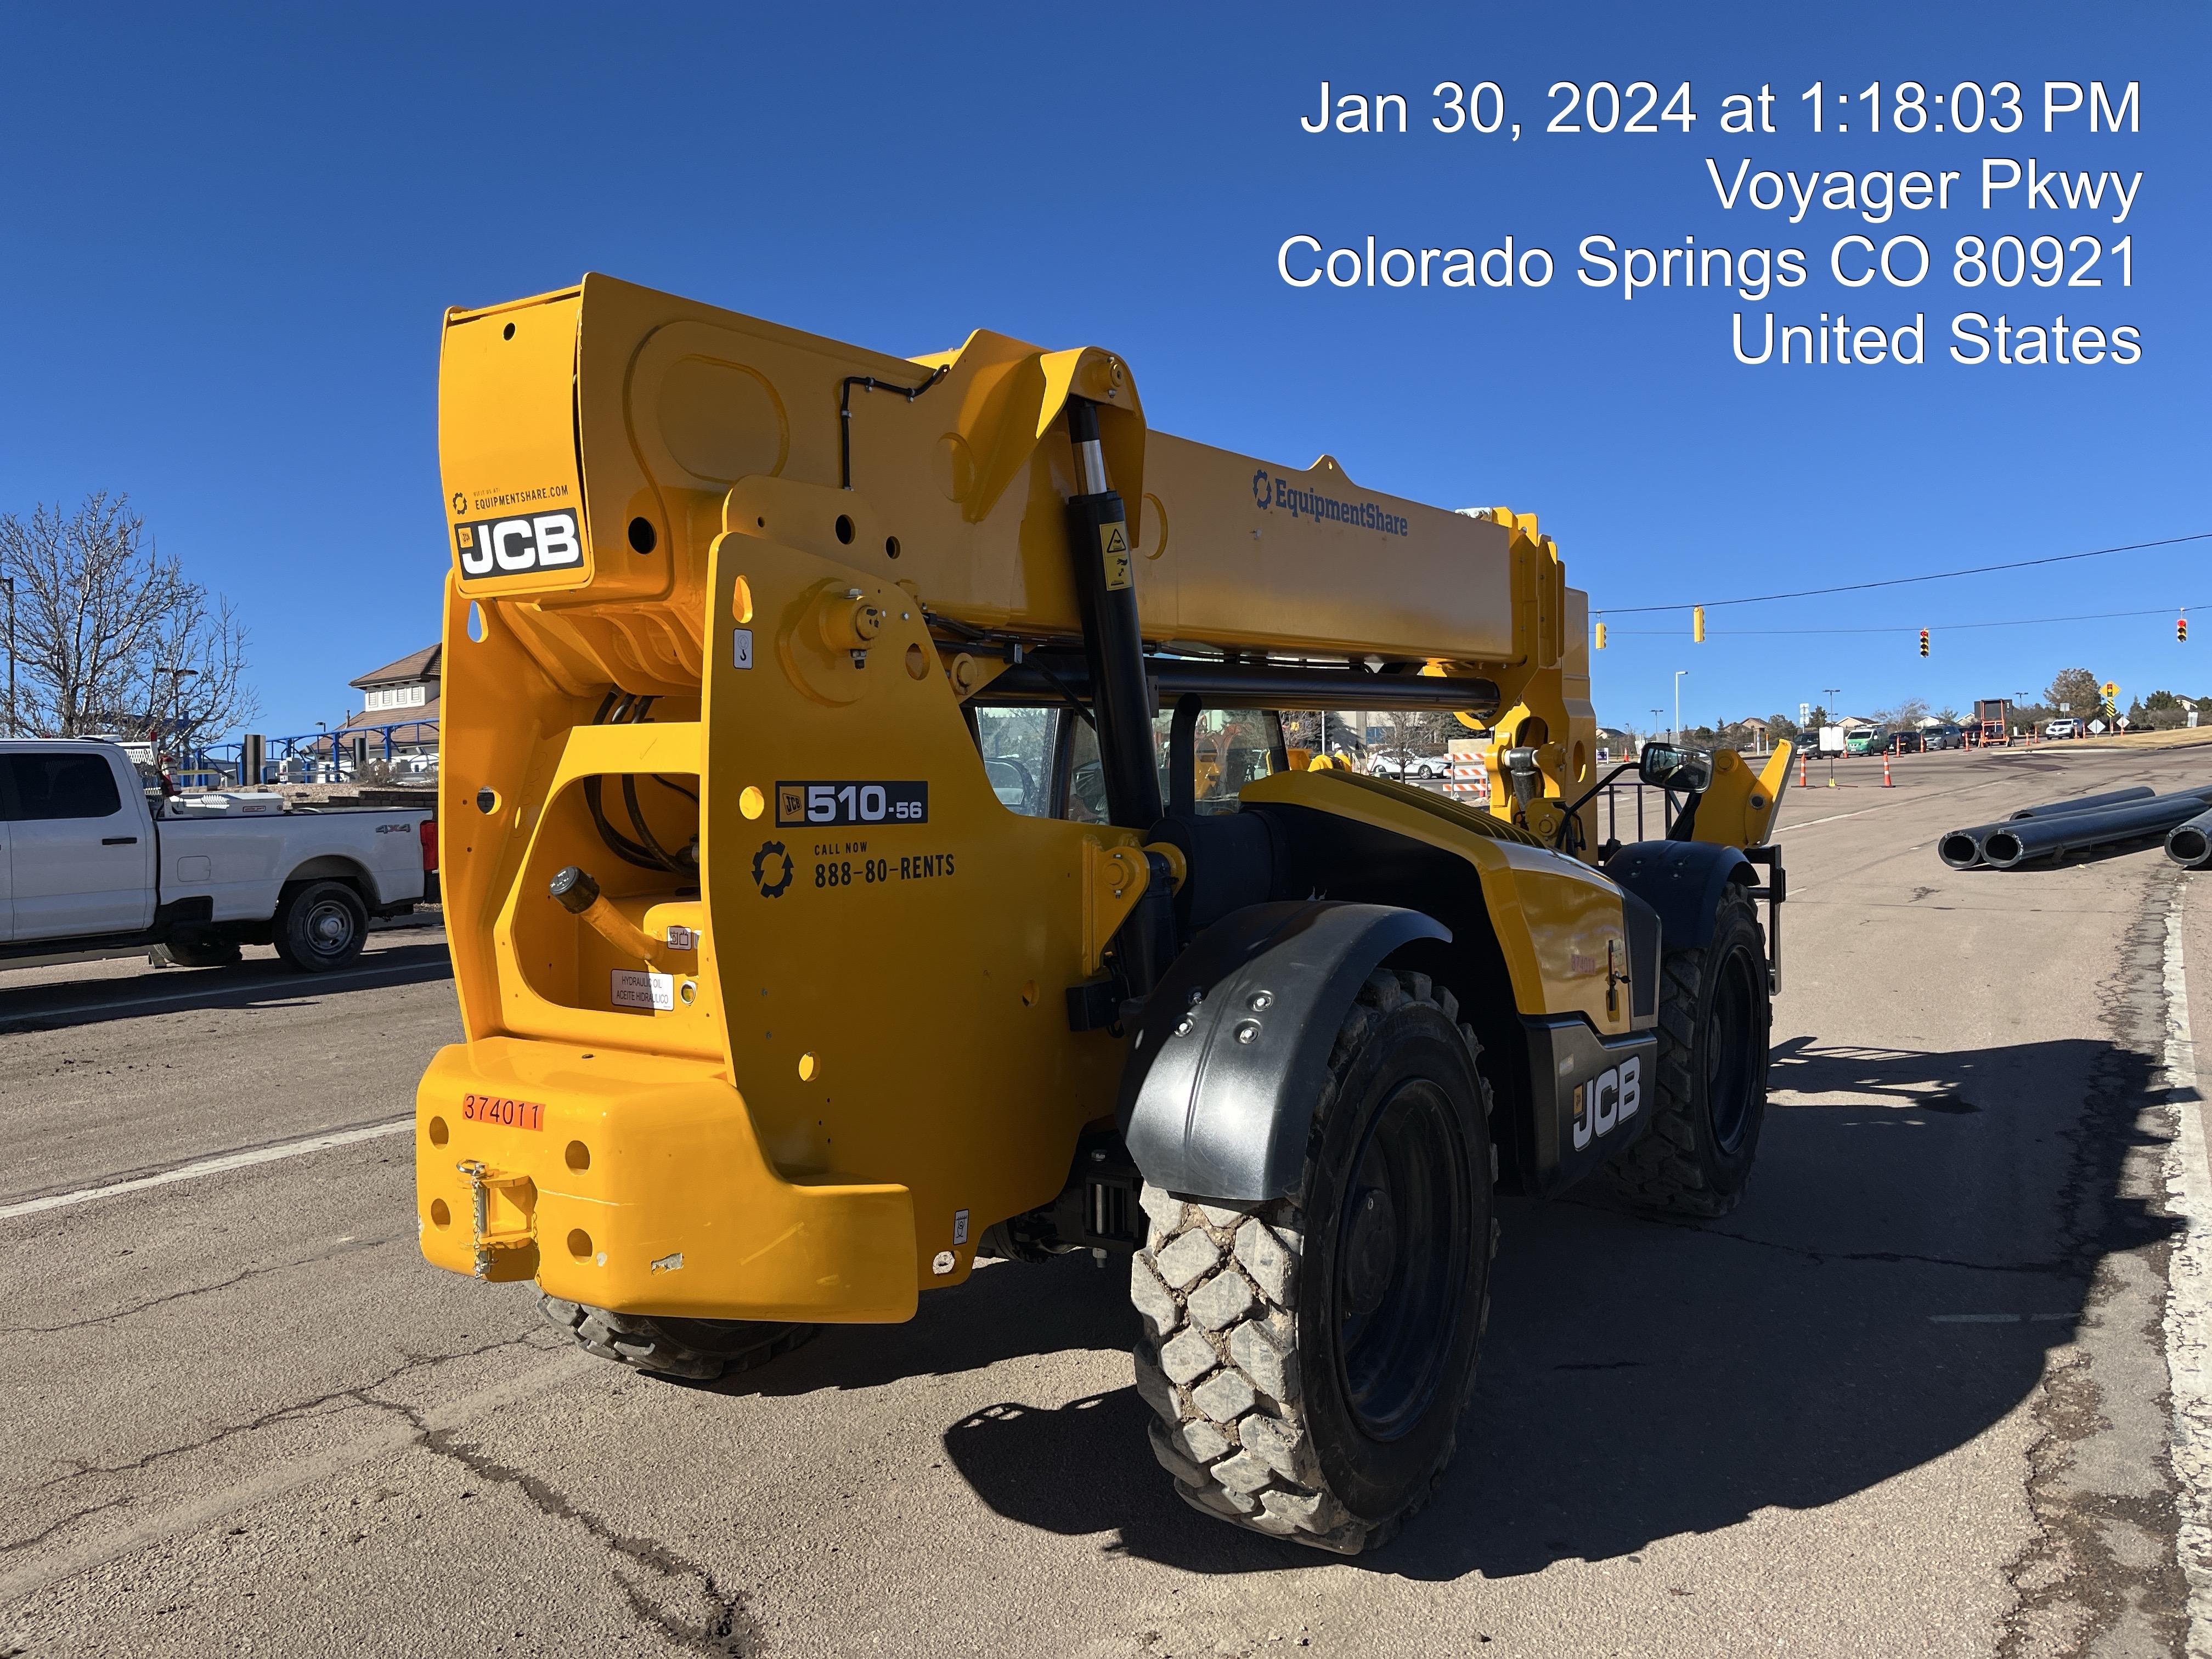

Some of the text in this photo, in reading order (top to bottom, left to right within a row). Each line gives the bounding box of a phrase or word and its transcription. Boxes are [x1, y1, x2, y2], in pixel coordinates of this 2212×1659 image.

[475, 484, 569, 510] EQUIPMENTSHARE.COM
[1275, 478, 1408, 537] EquipmentShare
[461, 514, 580, 574] JCB
[786, 795, 801, 812] JCB
[814, 841, 868, 856] CALL NOW
[815, 854, 955, 888] 888-80-RENTS
[616, 990, 635, 1001] ACEITE
[622, 975, 662, 989] HYDRAULIC OIL
[465, 1095, 539, 1129] 374011
[1573, 1056, 1641, 1152] JCB
